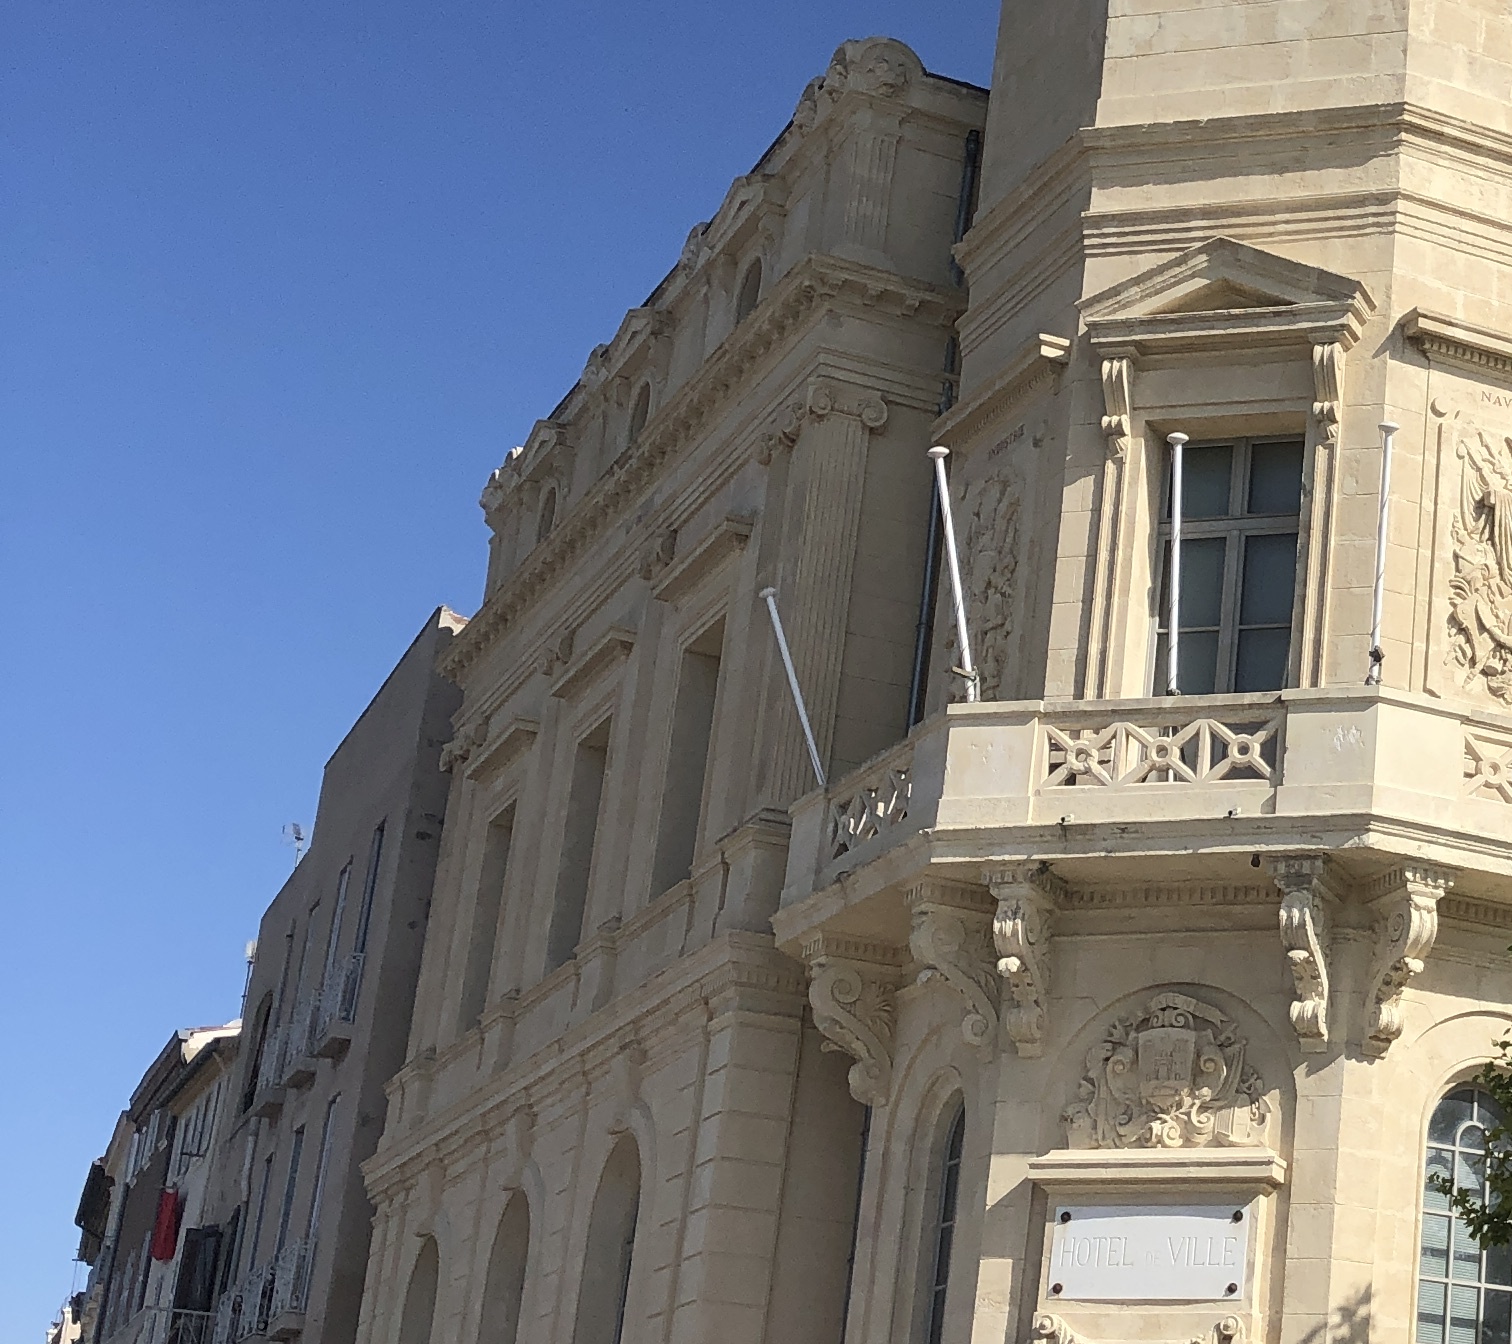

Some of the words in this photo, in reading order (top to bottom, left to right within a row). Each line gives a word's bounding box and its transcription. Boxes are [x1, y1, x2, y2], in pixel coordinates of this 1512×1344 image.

[1059, 1236, 1134, 1268] HOTEL
[1145, 1251, 1160, 1265] DE
[1167, 1236, 1238, 1268] VILLE
